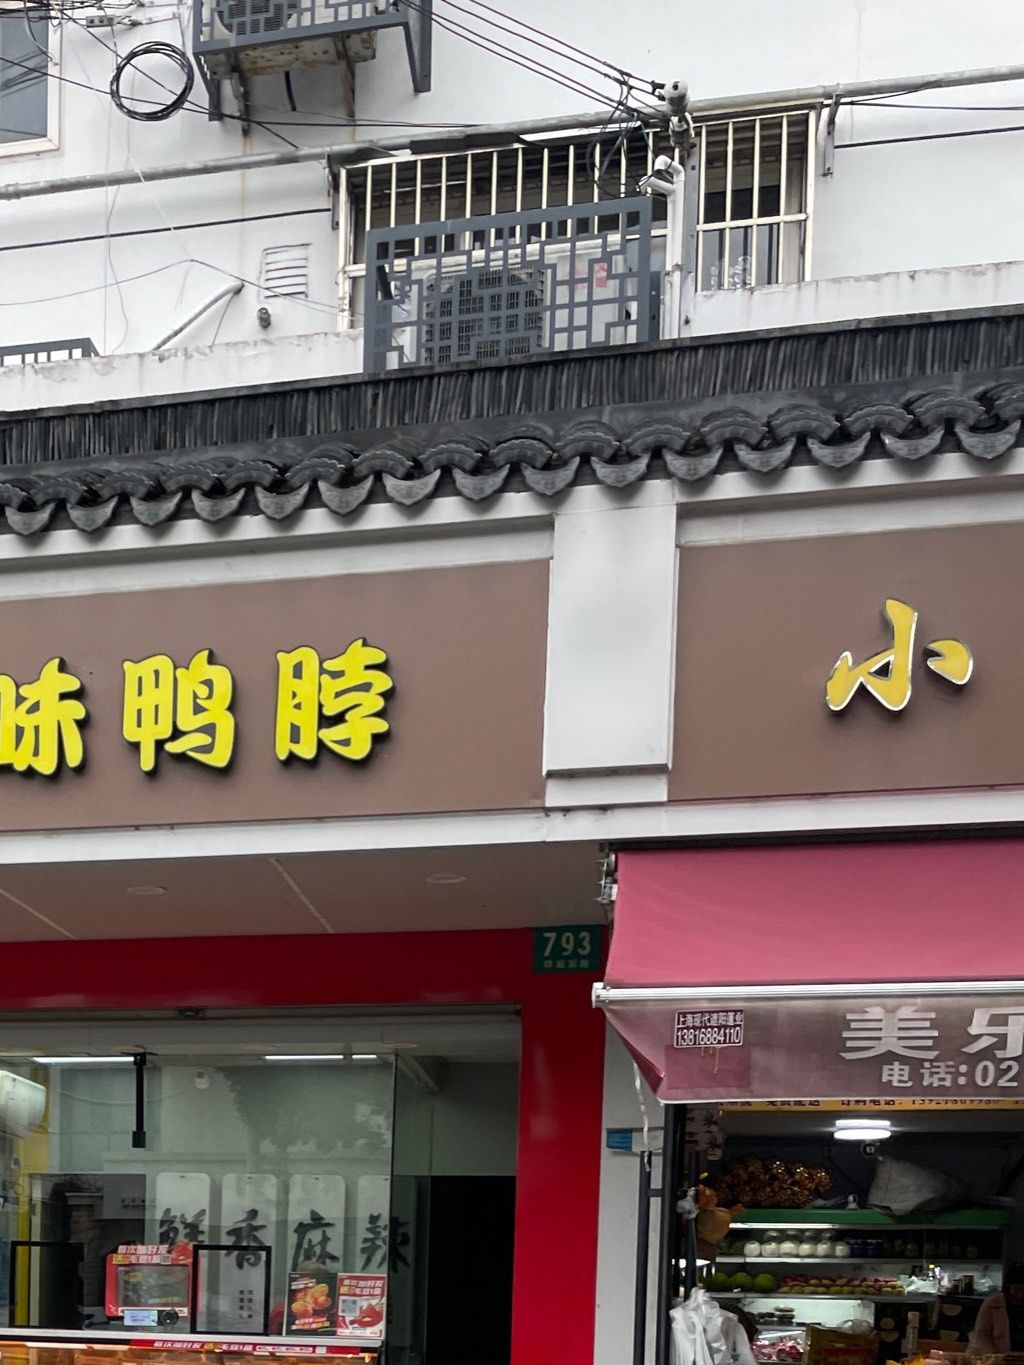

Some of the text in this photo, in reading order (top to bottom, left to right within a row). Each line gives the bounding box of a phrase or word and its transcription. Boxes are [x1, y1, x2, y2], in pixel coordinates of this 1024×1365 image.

[826, 598, 974, 712] 小
[543, 931, 592, 957] 793
[677, 1026, 741, 1046] 13816884110
